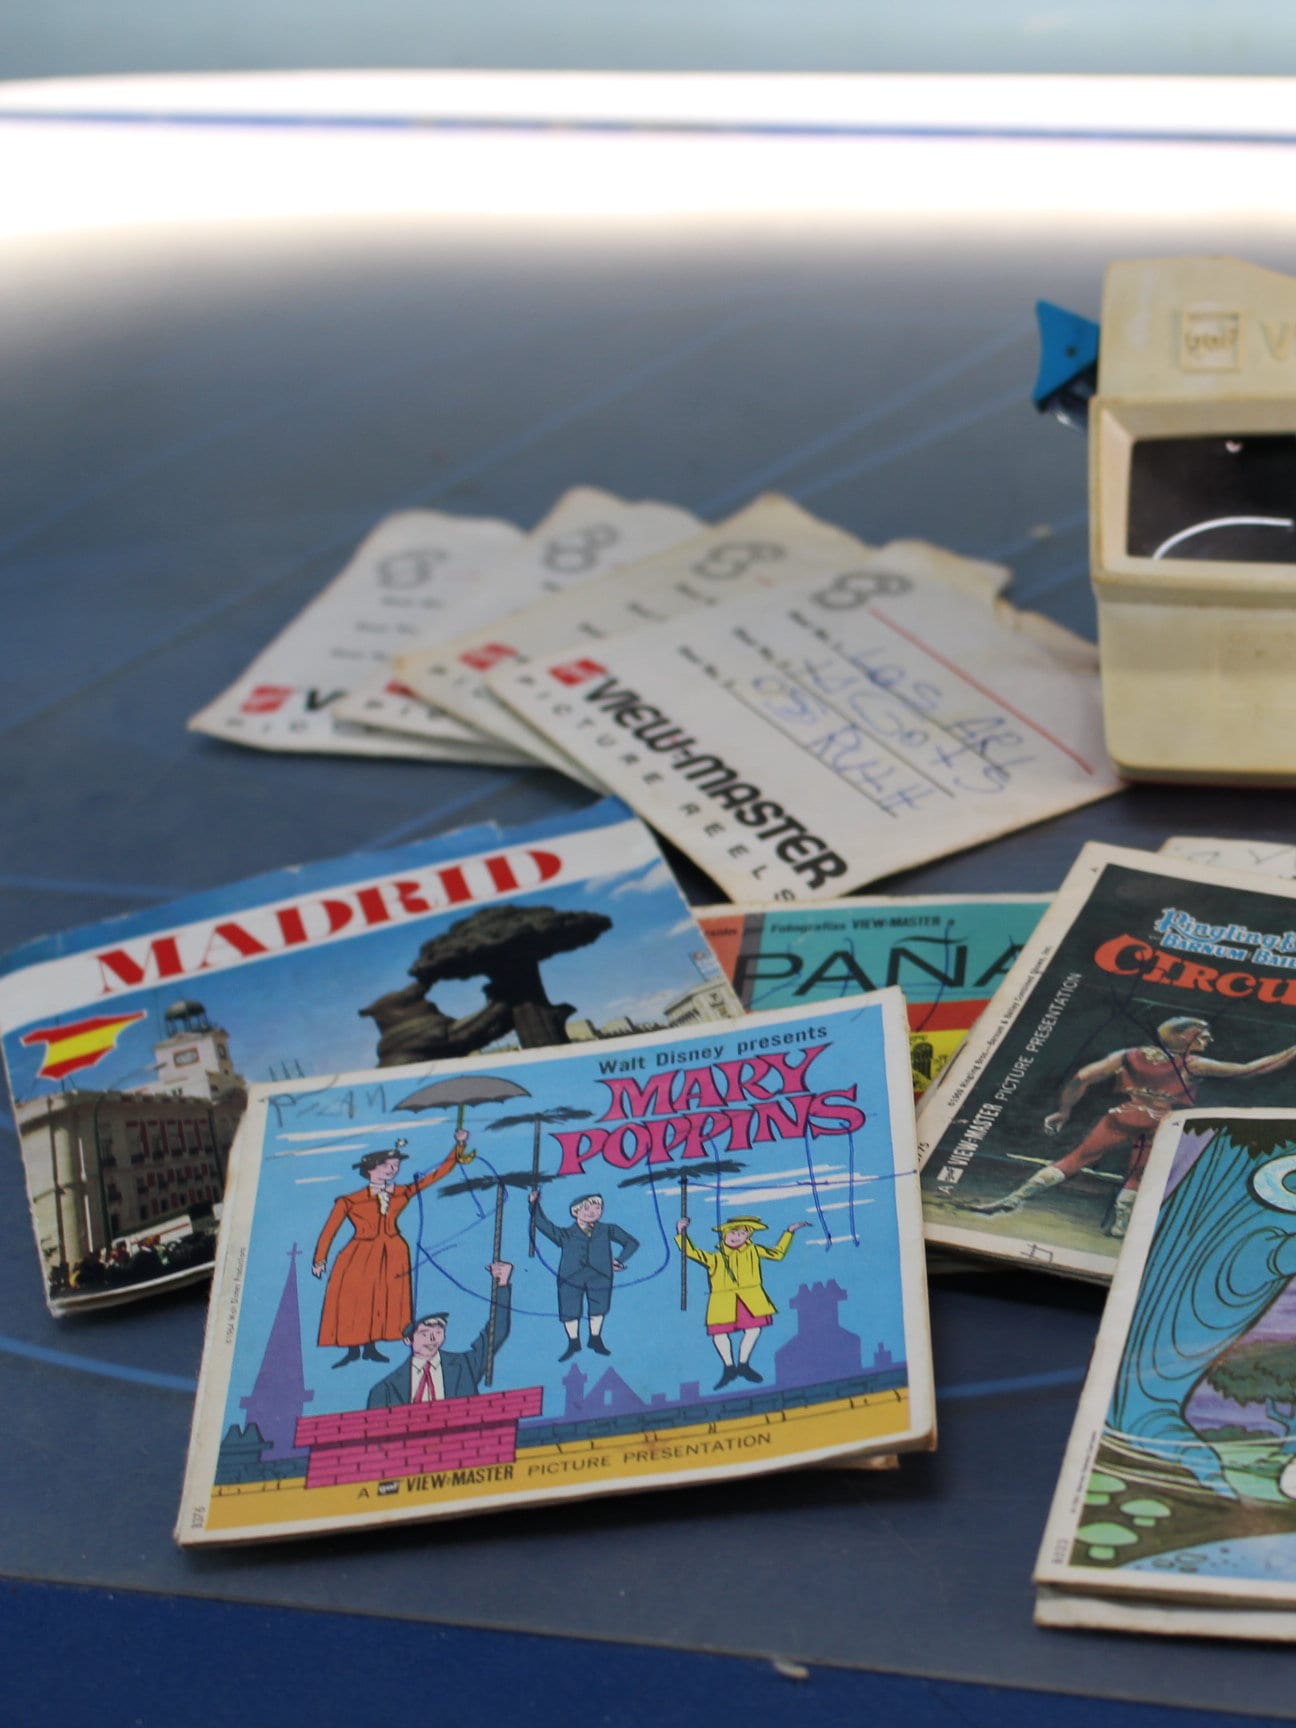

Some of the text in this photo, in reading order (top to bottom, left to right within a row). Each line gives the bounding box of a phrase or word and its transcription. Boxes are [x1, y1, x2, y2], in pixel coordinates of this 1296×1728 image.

[514, 675, 796, 904] PICTURE REELS
[94, 849, 563, 994] MADRID
[1153, 907, 1279, 951] Ringling
[1160, 931, 1249, 962] BARNUM
[599, 1025, 828, 1076] Walt Disney presents
[995, 1055, 1035, 1101] PICTURE
[1026, 972, 1083, 1054] PRESENTATION
[595, 1042, 833, 1123] MARY
[549, 1083, 866, 1176] POPPINS
[357, 1487, 370, 1500] A
[527, 1456, 611, 1477] PICTURE
[623, 1433, 772, 1465] PRESENTATION
